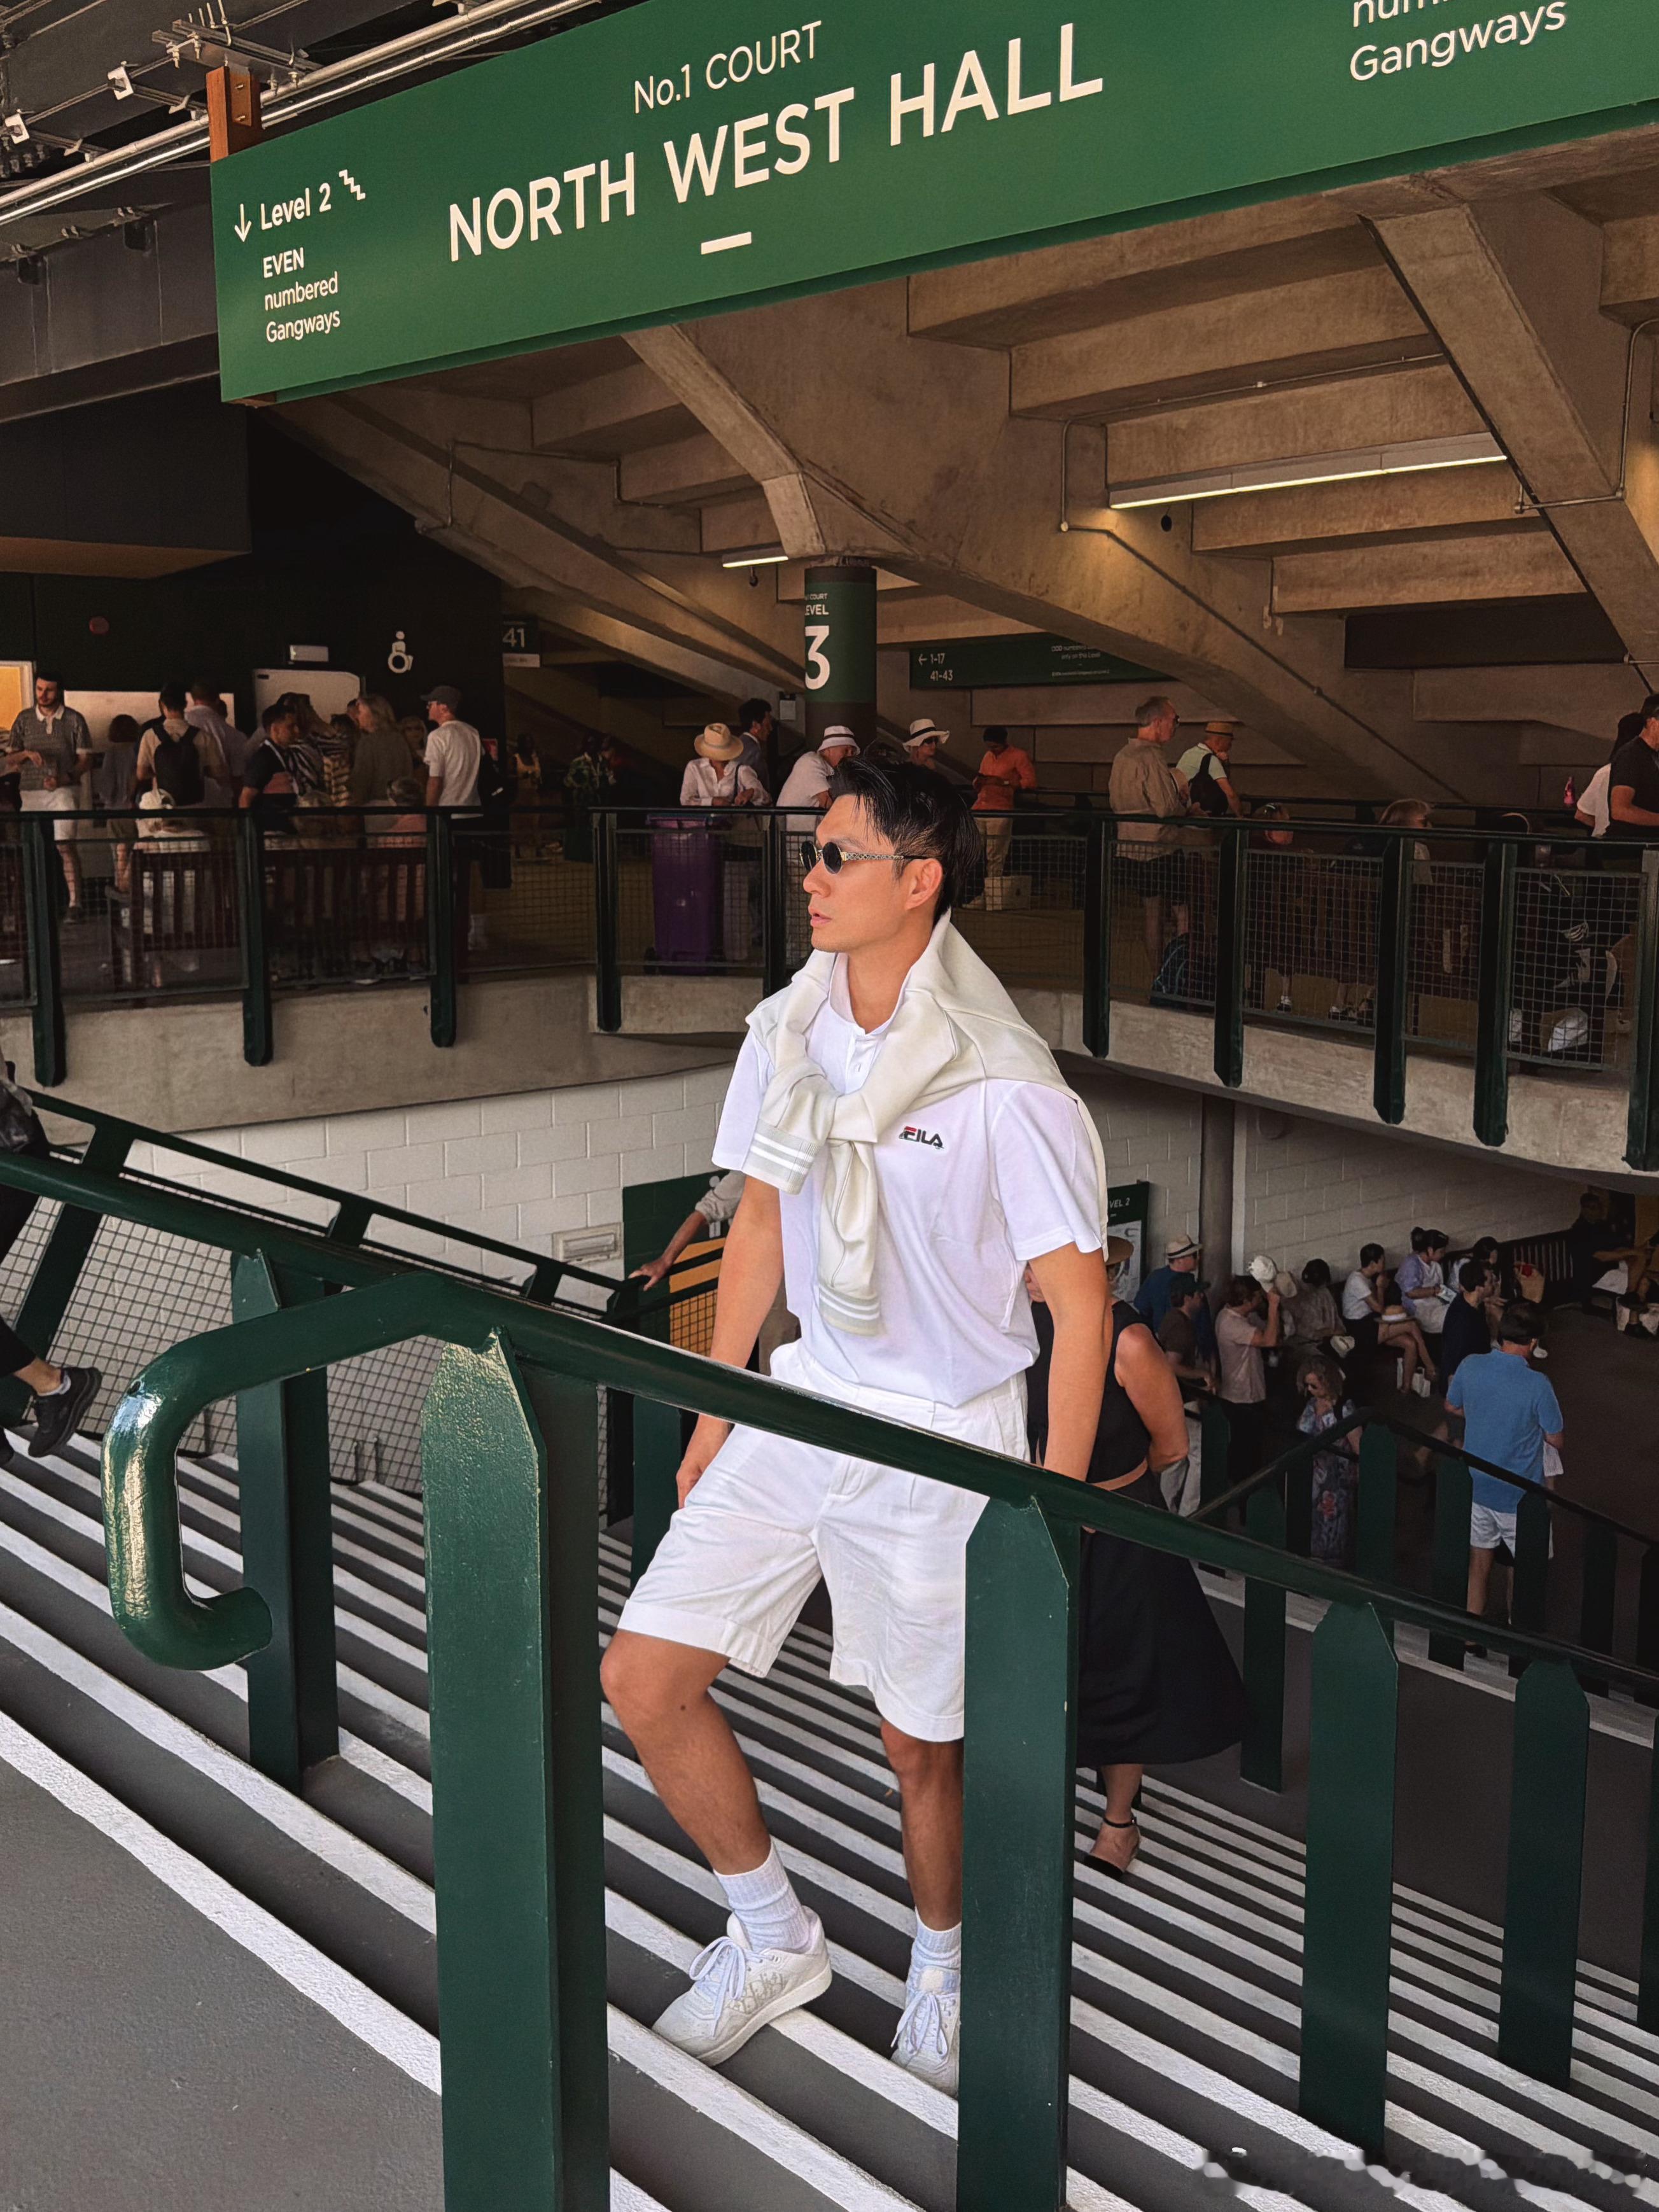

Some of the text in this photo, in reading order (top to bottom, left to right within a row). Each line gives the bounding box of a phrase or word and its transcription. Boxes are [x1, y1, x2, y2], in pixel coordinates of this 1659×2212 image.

[1350, 1, 1567, 81] Gangways
[634, 20, 822, 114] No.1 COURT
[449, 23, 1103, 262] NORTH WEST HALL
[260, 183, 332, 230] Level 2
[263, 247, 304, 279] EVEN
[265, 270, 339, 311] numbered
[266, 311, 340, 343] Gangways
[805, 604, 829, 616] EVEL
[503, 627, 525, 648] 41
[805, 626, 830, 690] 3
[930, 652, 946, 664] 1-17
[930, 669, 953, 681] 41-43
[899, 1126, 944, 1149] FILA
